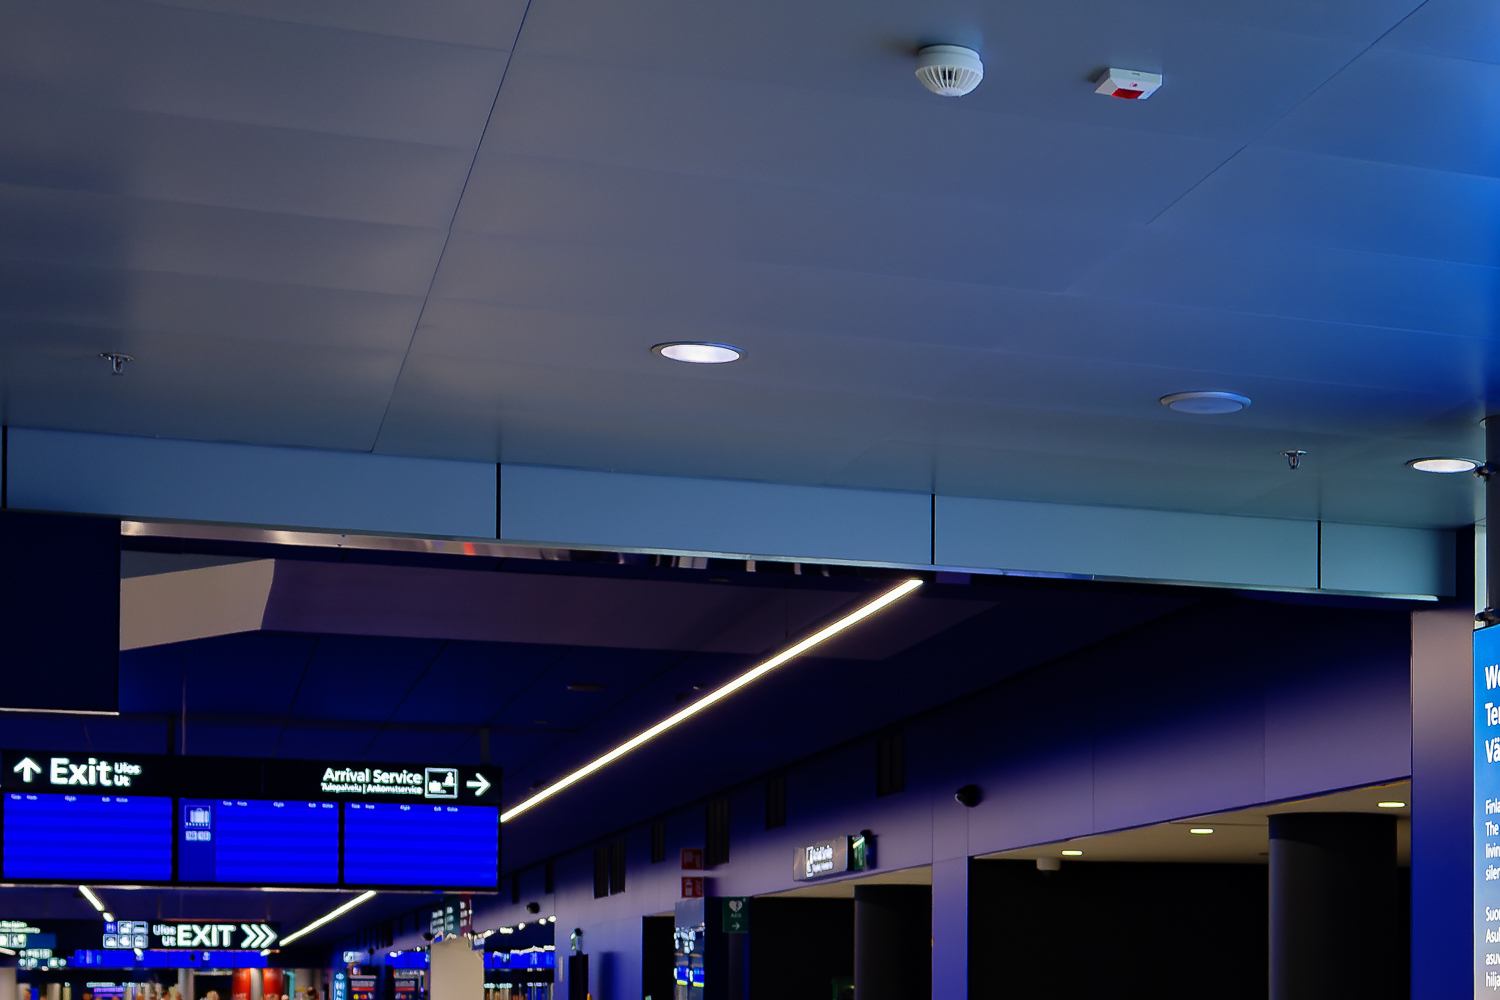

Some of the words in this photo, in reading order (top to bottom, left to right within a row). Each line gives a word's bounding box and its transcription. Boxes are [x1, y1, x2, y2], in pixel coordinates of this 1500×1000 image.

[50, 757, 113, 787] Exit
[322, 767, 371, 784] Arrival
[373, 769, 423, 785] Service
[1484, 820, 1499, 837] The
[177, 923, 237, 947] EXIT
